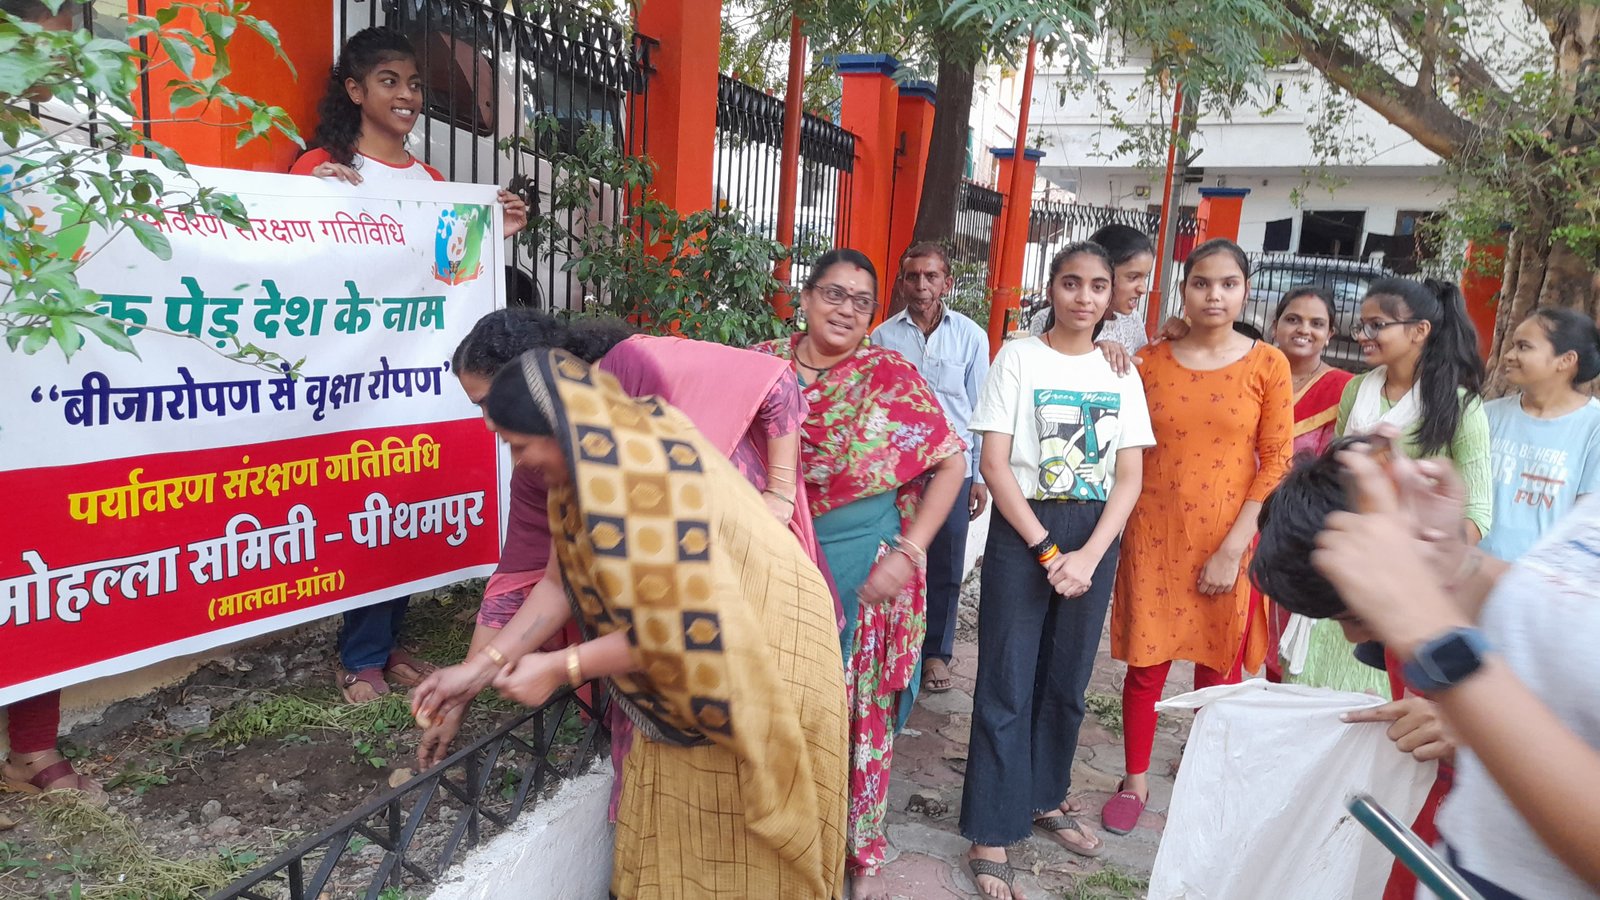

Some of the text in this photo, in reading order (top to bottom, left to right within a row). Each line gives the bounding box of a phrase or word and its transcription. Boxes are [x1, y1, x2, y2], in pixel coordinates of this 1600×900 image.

[124, 199, 228, 240] र्यावरण
[318, 210, 406, 246] गतिविधि
[165, 277, 240, 348] पेड़
[253, 280, 327, 338] देश
[334, 280, 373, 333] के
[380, 293, 446, 332] नाम
[269, 364, 297, 410] से
[305, 371, 366, 422] वृक्षा
[67, 433, 441, 525] पर्यावरण संरक्षण गतिविधि
[1491, 438, 1568, 466] WILL BE HERE
[1491, 452, 1517, 485] OR
[1514, 489, 1555, 510] FUN
[0, 546, 181, 626] मोहल्ला
[187, 503, 318, 585] समिती
[348, 490, 485, 548] पीथमपुर
[208, 566, 346, 622] (मालवा-प्रांत)
